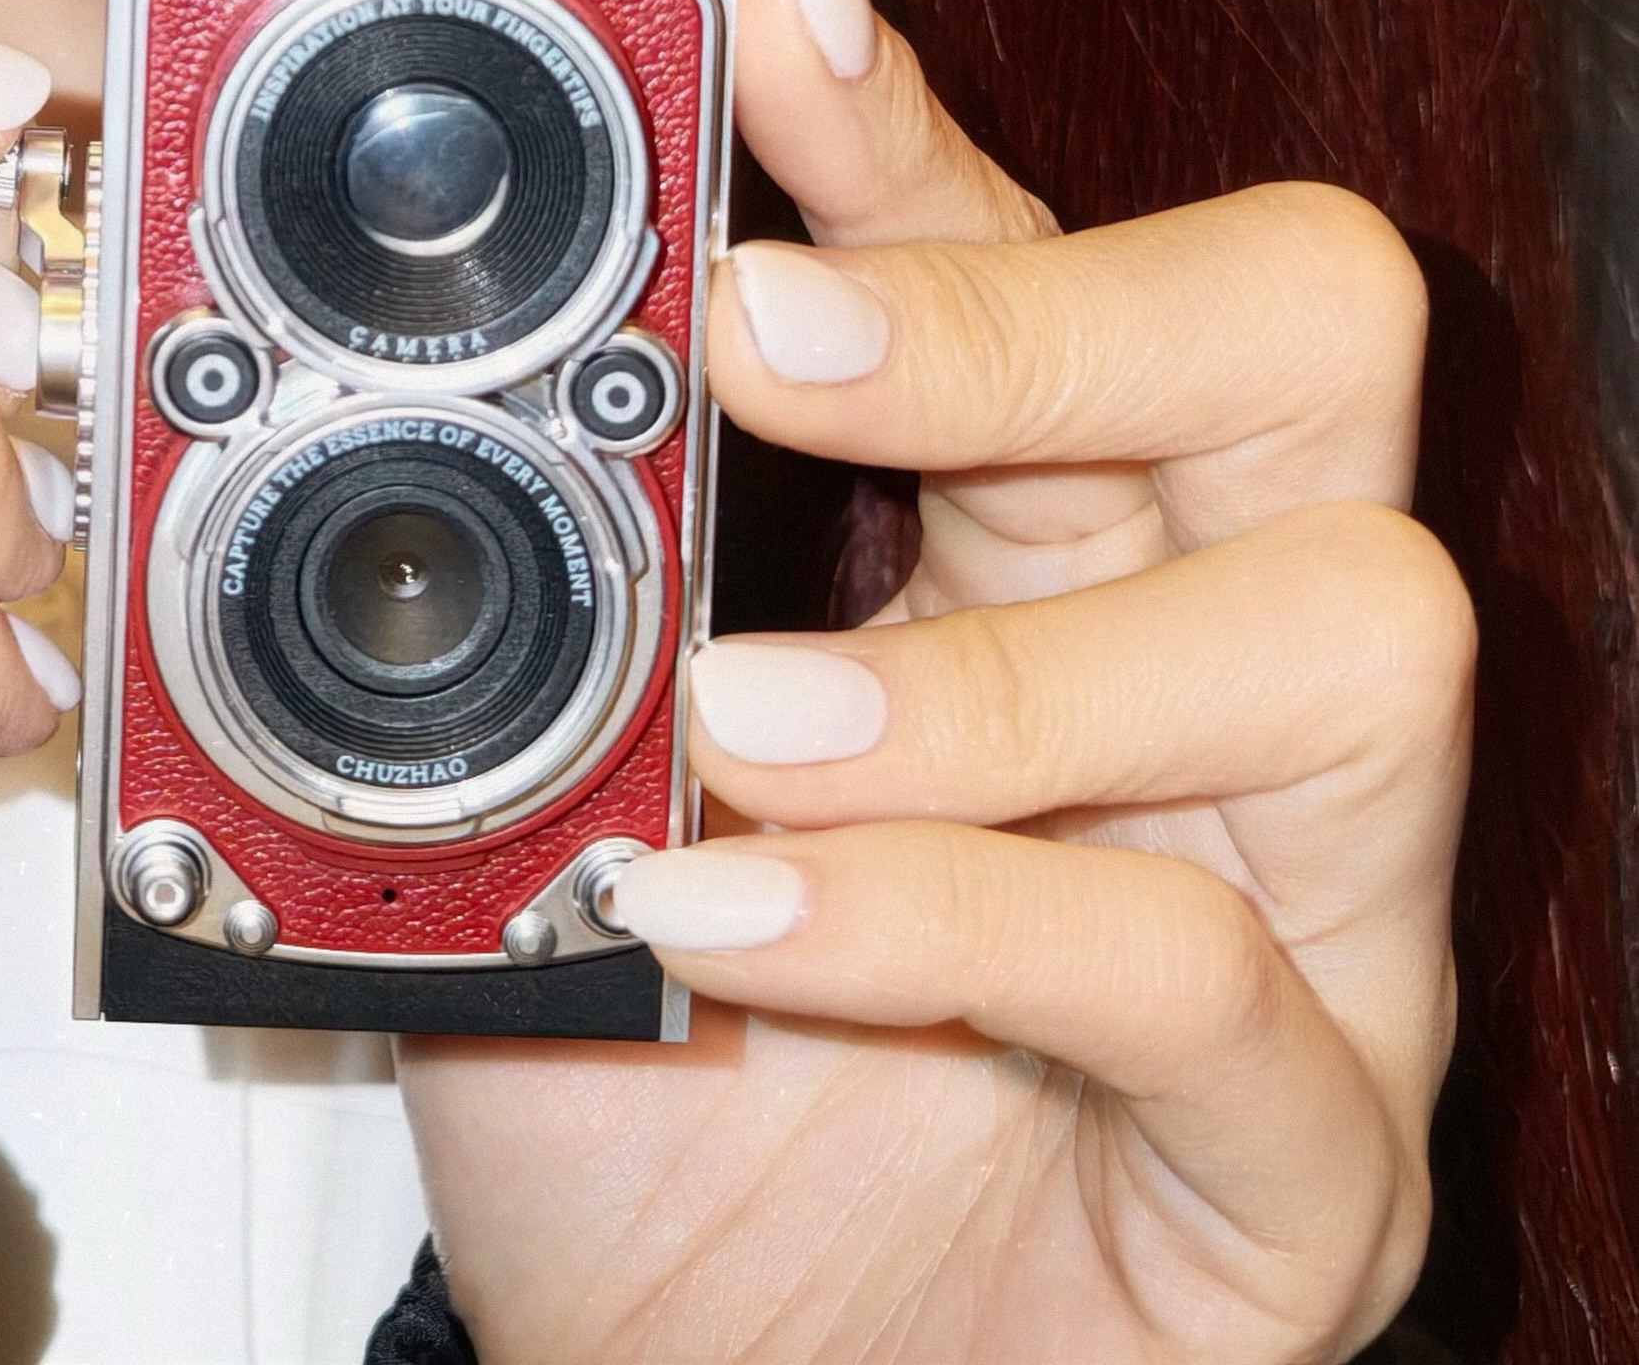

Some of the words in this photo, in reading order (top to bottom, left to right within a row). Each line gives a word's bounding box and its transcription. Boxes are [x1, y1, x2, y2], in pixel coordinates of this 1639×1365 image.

[250, 5, 379, 121] INSPIRATION
[492, 9, 602, 128] FINGERTIPS
[349, 326, 488, 358] CAMERA
[222, 485, 283, 596] CAPTURE
[273, 444, 326, 487] THE
[325, 421, 436, 456] ESSENCE
[438, 425, 475, 449] OF
[474, 438, 549, 495] EVERY
[539, 494, 593, 607] MOMENT
[336, 755, 468, 784] CHUZHAO
